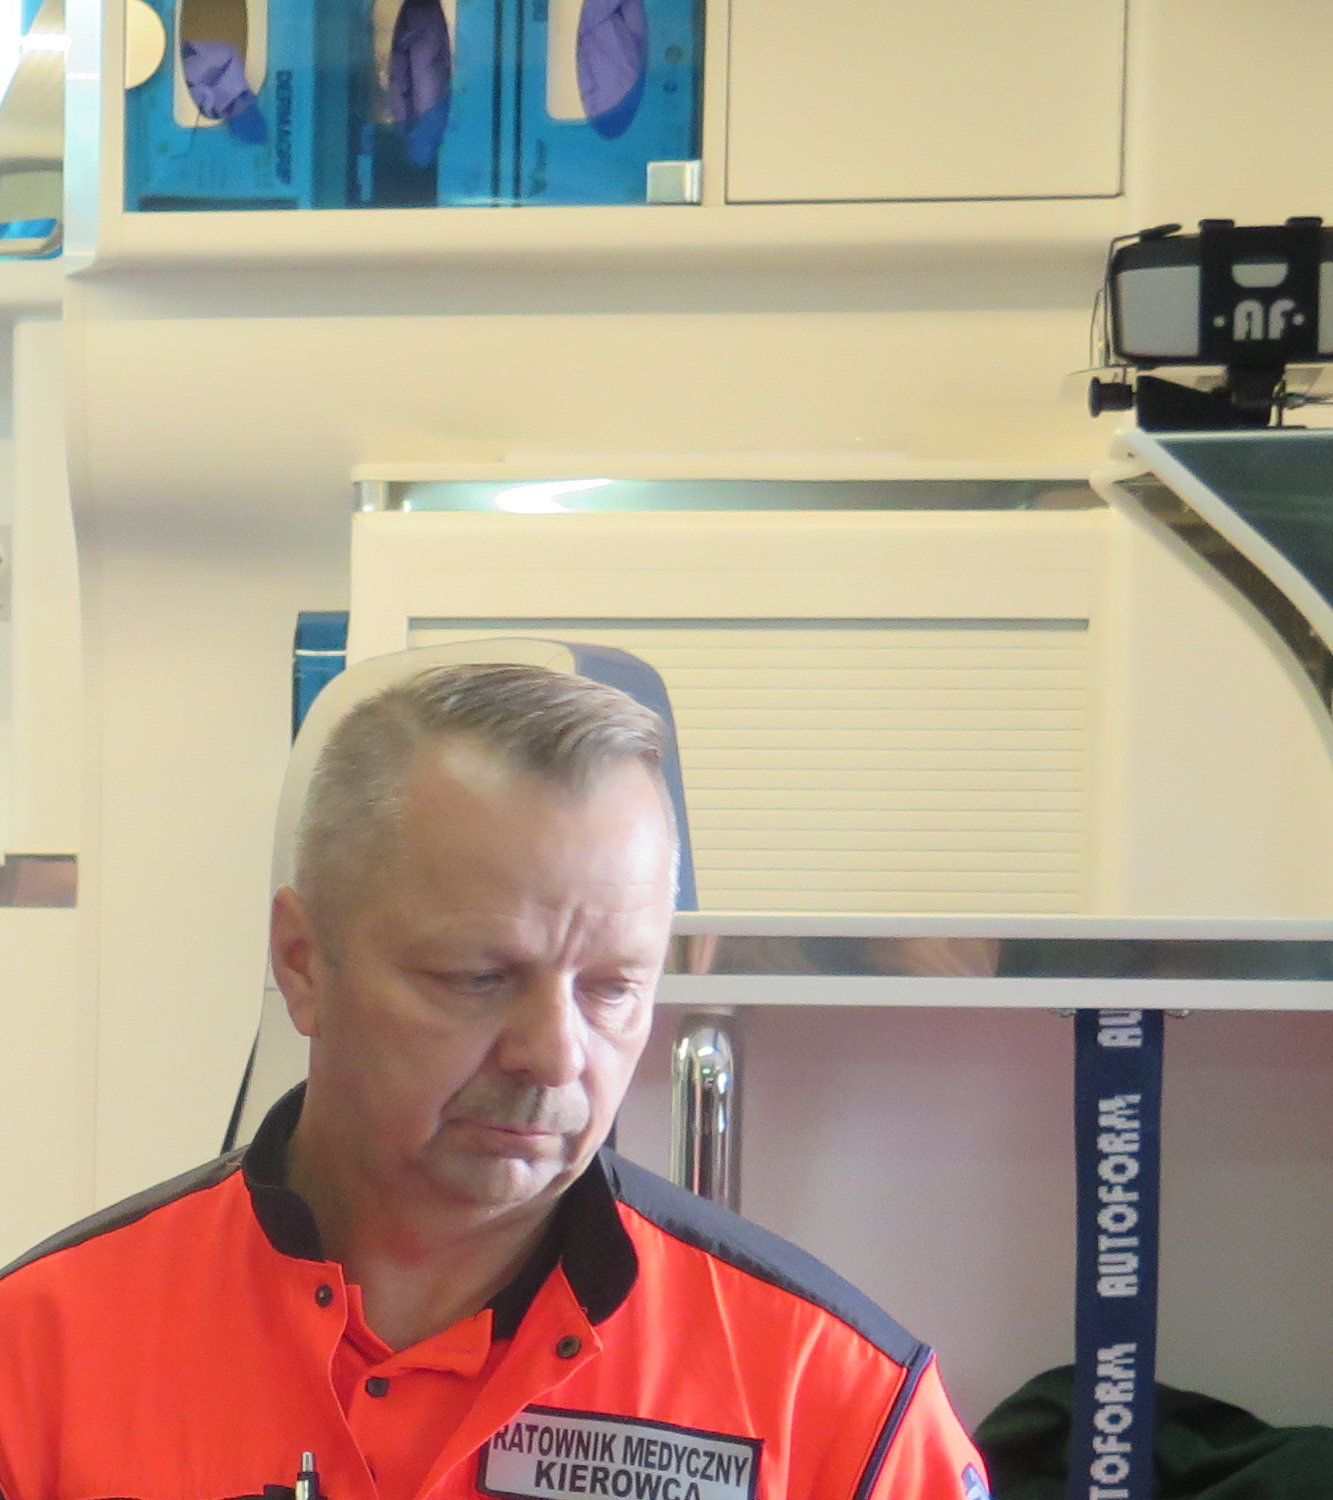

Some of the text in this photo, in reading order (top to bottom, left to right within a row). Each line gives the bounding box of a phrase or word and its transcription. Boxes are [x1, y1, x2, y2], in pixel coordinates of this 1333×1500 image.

[1096, 1093, 1142, 1298] AUTOFORM
[493, 1423, 749, 1488] RATOWNIK MEDYCZNY
